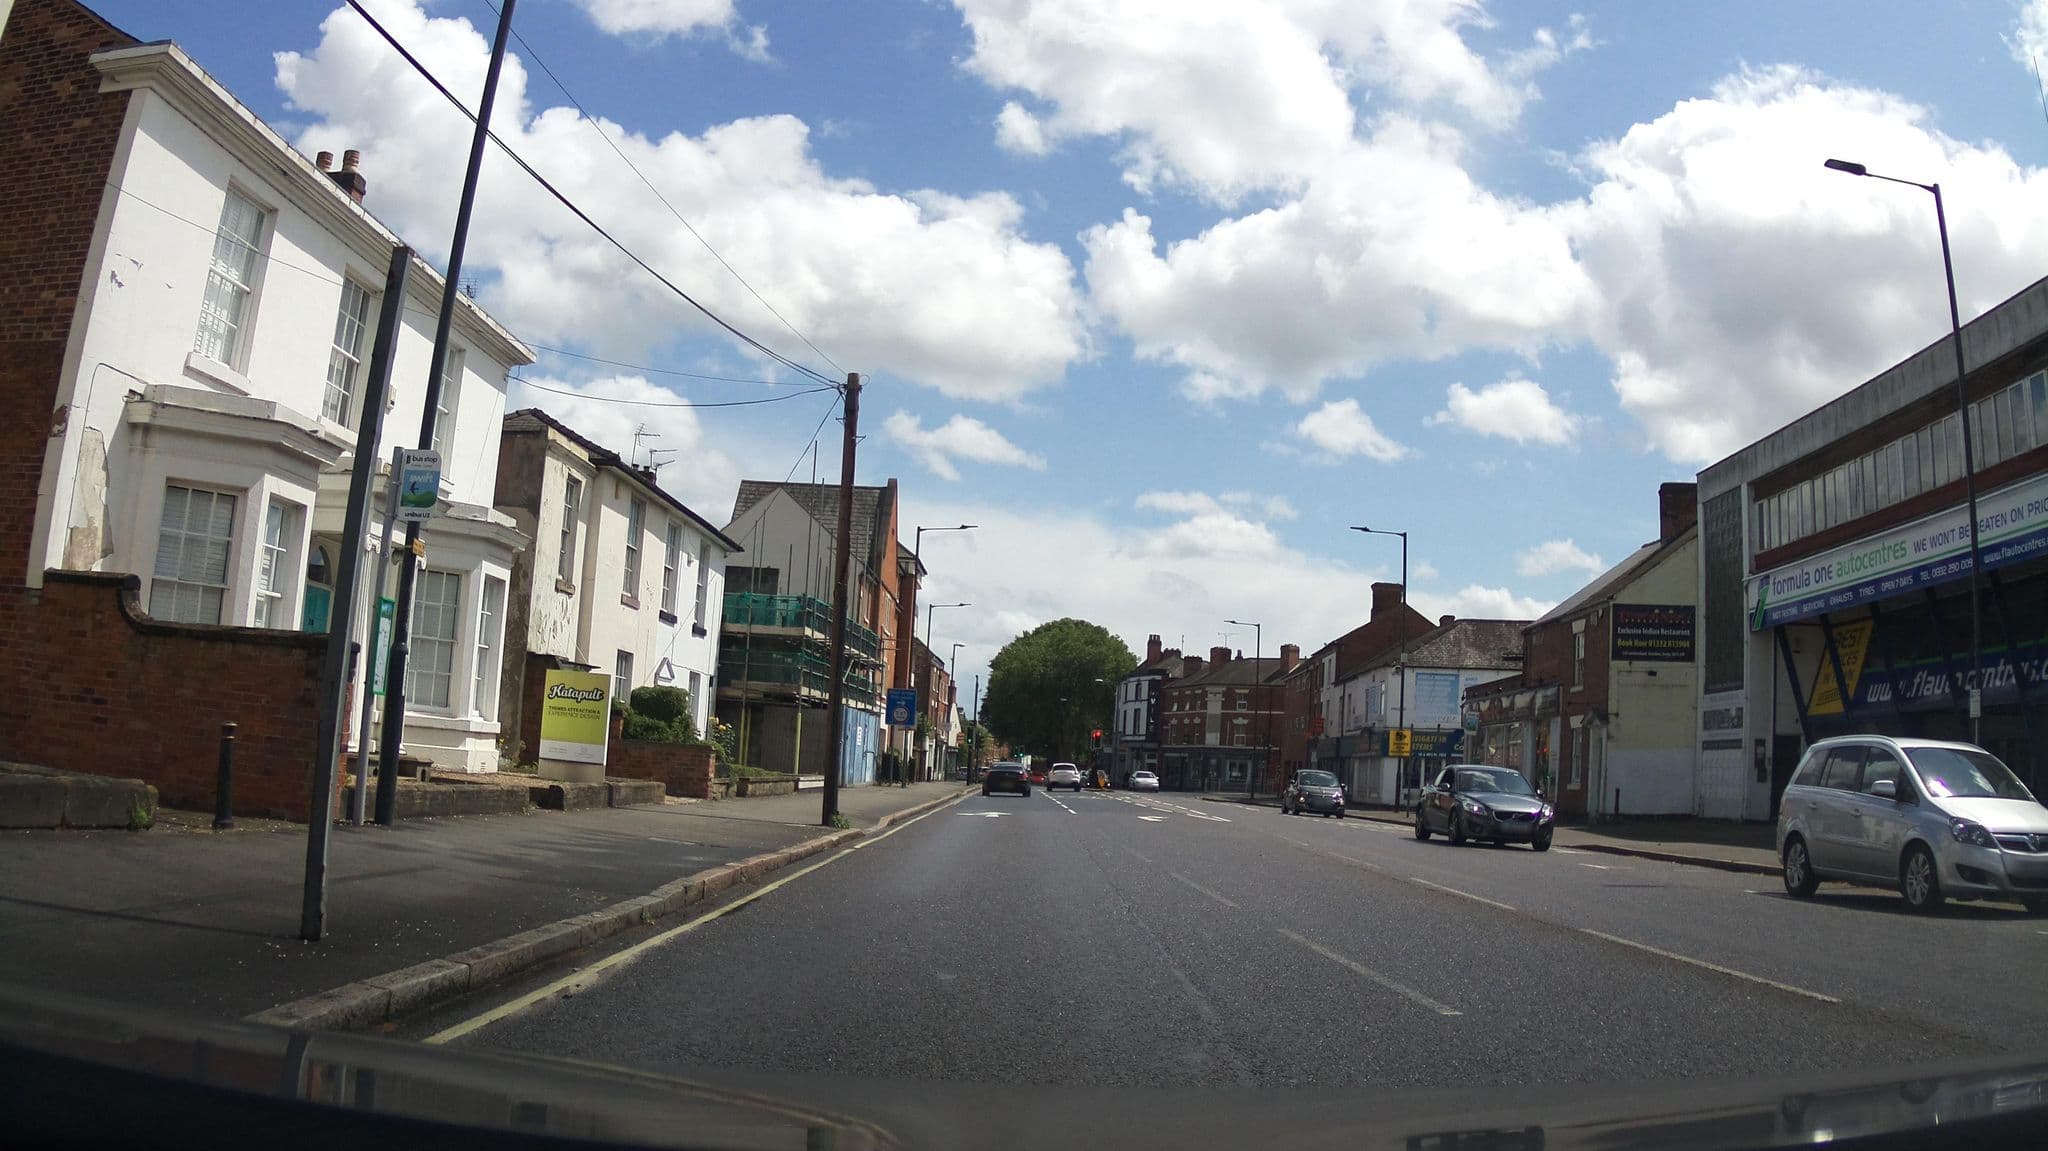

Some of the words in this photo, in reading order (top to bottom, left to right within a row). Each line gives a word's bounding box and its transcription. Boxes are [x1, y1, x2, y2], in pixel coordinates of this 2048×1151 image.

[1913, 536, 1927, 554] WE
[1929, 528, 1955, 548] WON'T
[1959, 525, 1971, 541] BE
[2010, 505, 2024, 524] ON
[1772, 568, 1811, 597] formula
[1814, 564, 1833, 584] one
[1836, 540, 1908, 578] autocentres
[1859, 585, 1875, 598] TYRES
[548, 683, 604, 703] Katapult
